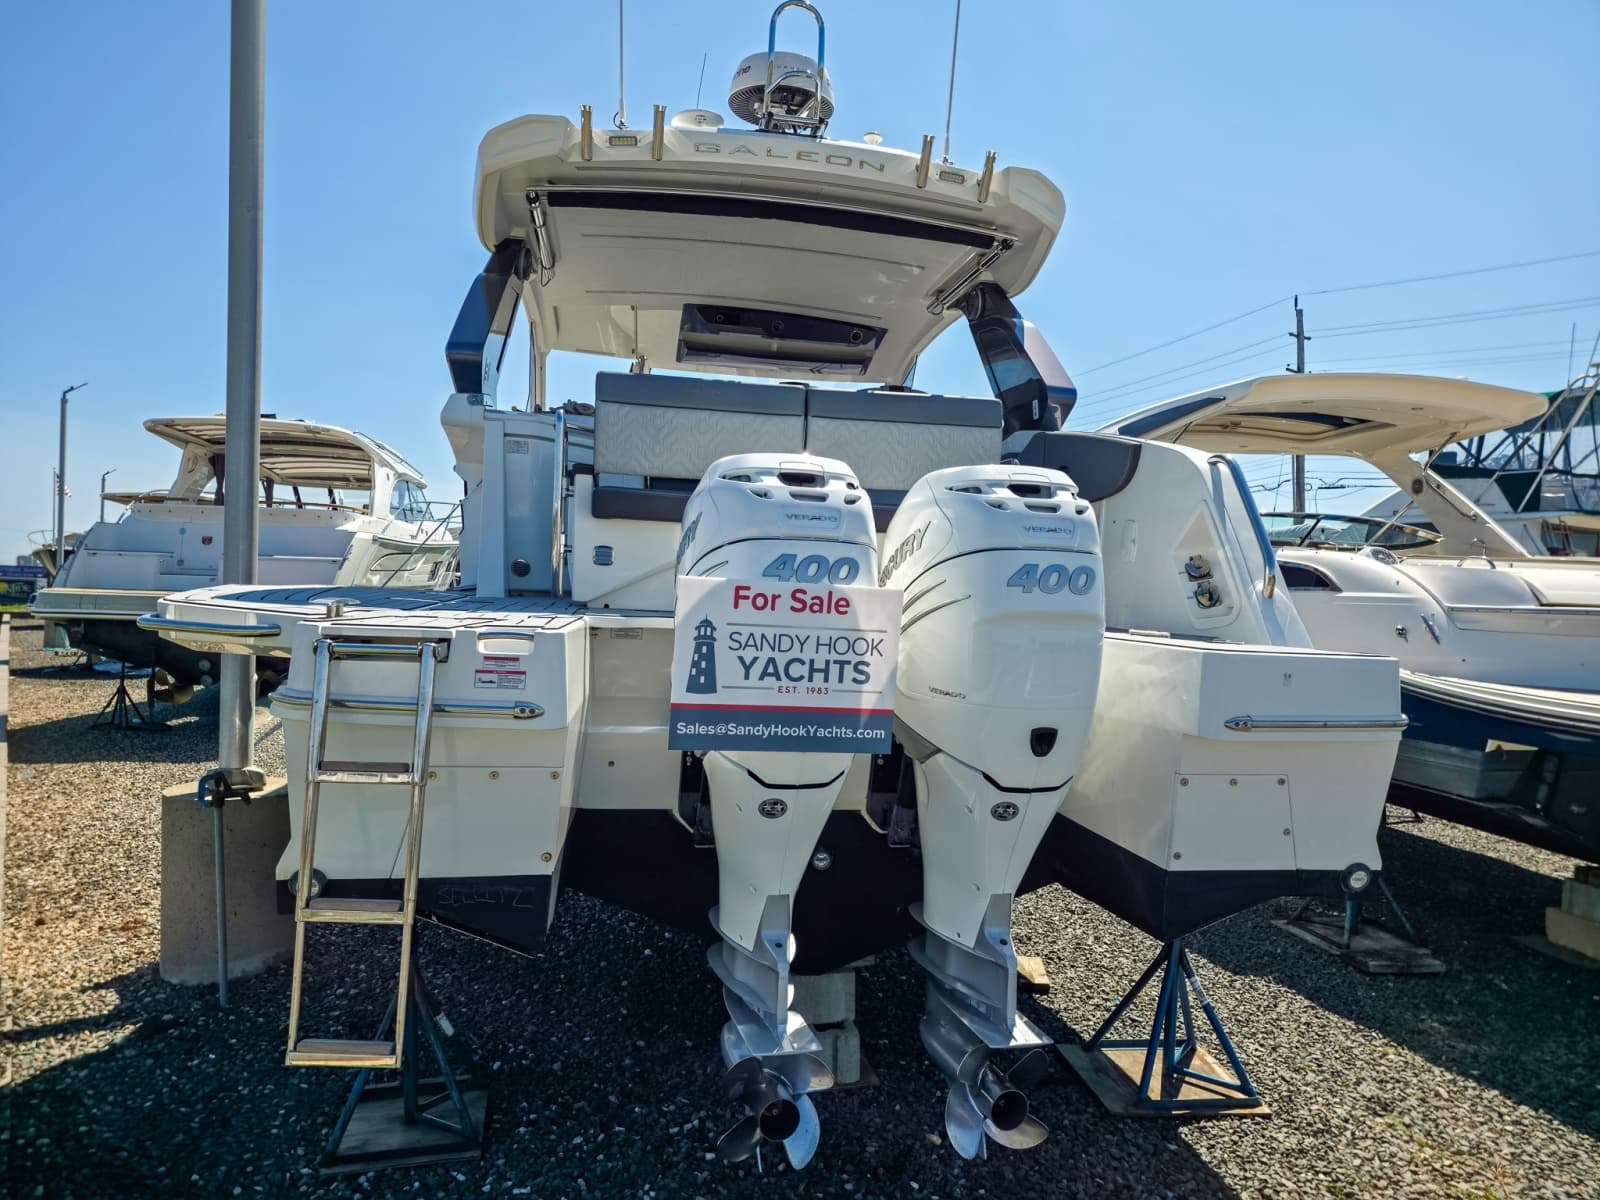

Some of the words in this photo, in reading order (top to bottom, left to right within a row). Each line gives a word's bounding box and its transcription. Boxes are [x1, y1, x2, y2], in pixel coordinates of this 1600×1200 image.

[694, 142, 885, 173] GALEON
[784, 512, 838, 523] VERADO
[762, 553, 860, 585] 400
[1006, 563, 1097, 596] 400
[733, 585, 781, 612] For
[790, 588, 851, 615] Sale
[728, 631, 810, 654] SANDY
[816, 635, 885, 658] HOOK
[737, 655, 872, 685] YACHTS
[777, 685, 800, 694] EST.
[806, 686, 829, 695] 1983
[676, 722, 885, 740] Sales@SandyHookYachts.com
